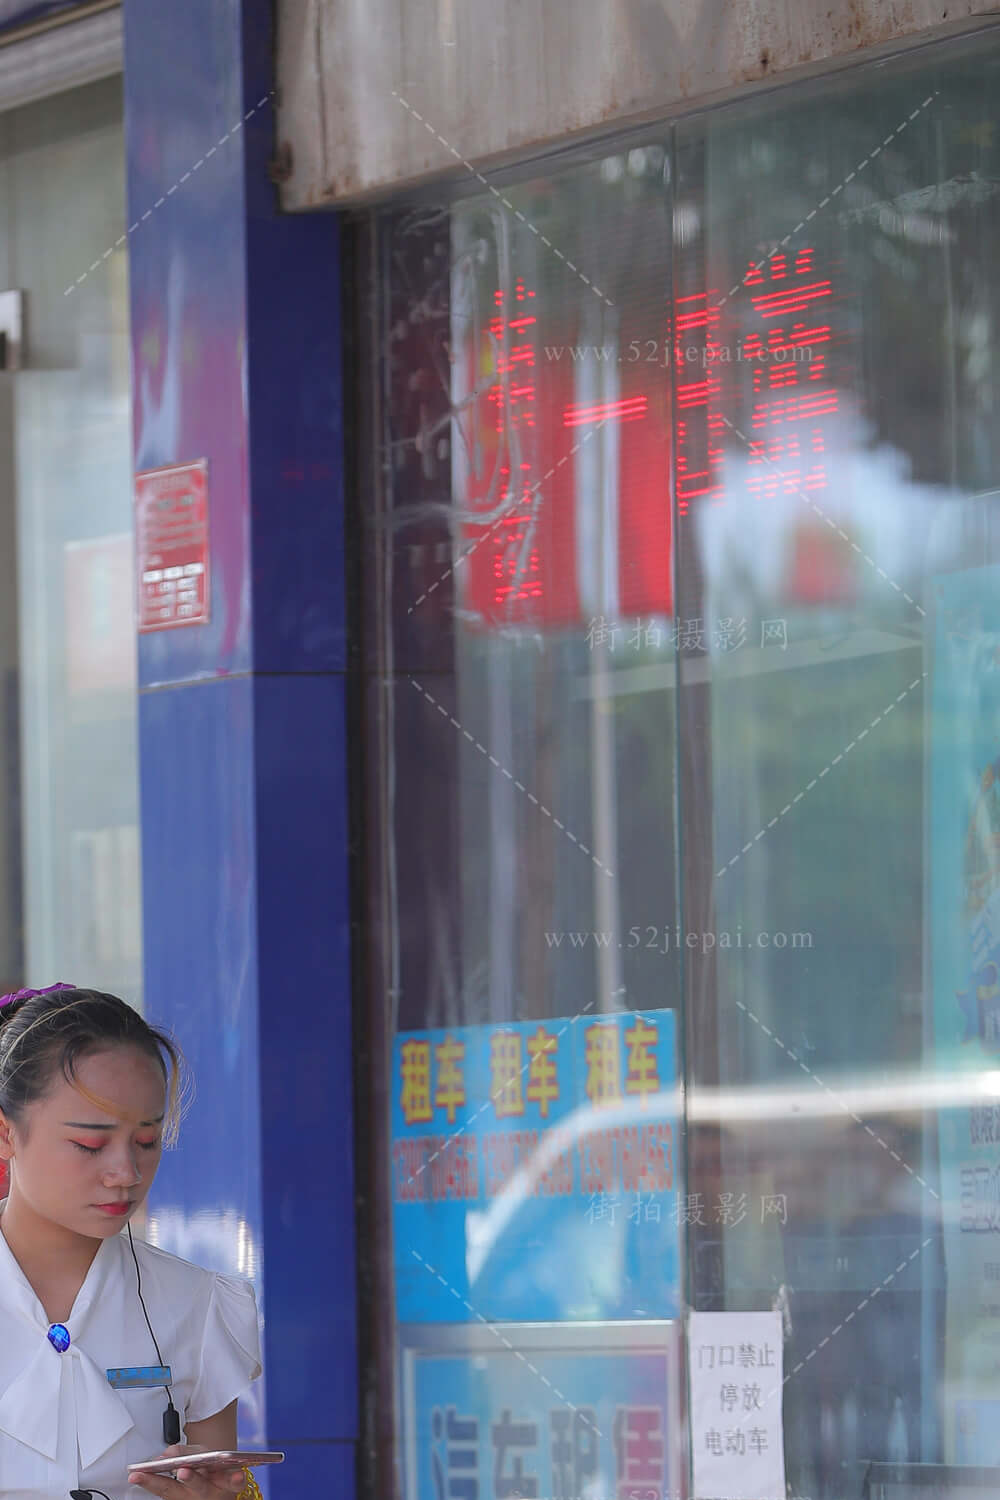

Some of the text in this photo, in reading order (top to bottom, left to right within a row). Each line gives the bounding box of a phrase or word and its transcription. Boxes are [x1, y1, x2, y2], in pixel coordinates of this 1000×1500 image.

[402, 1033, 466, 1125] 租车
[489, 1026, 560, 1119] 租车
[585, 1018, 660, 1112] 租车
[698, 1342, 775, 1370] 门口禁止
[720, 1382, 762, 1412] 停放
[705, 1427, 769, 1457] 电动车
